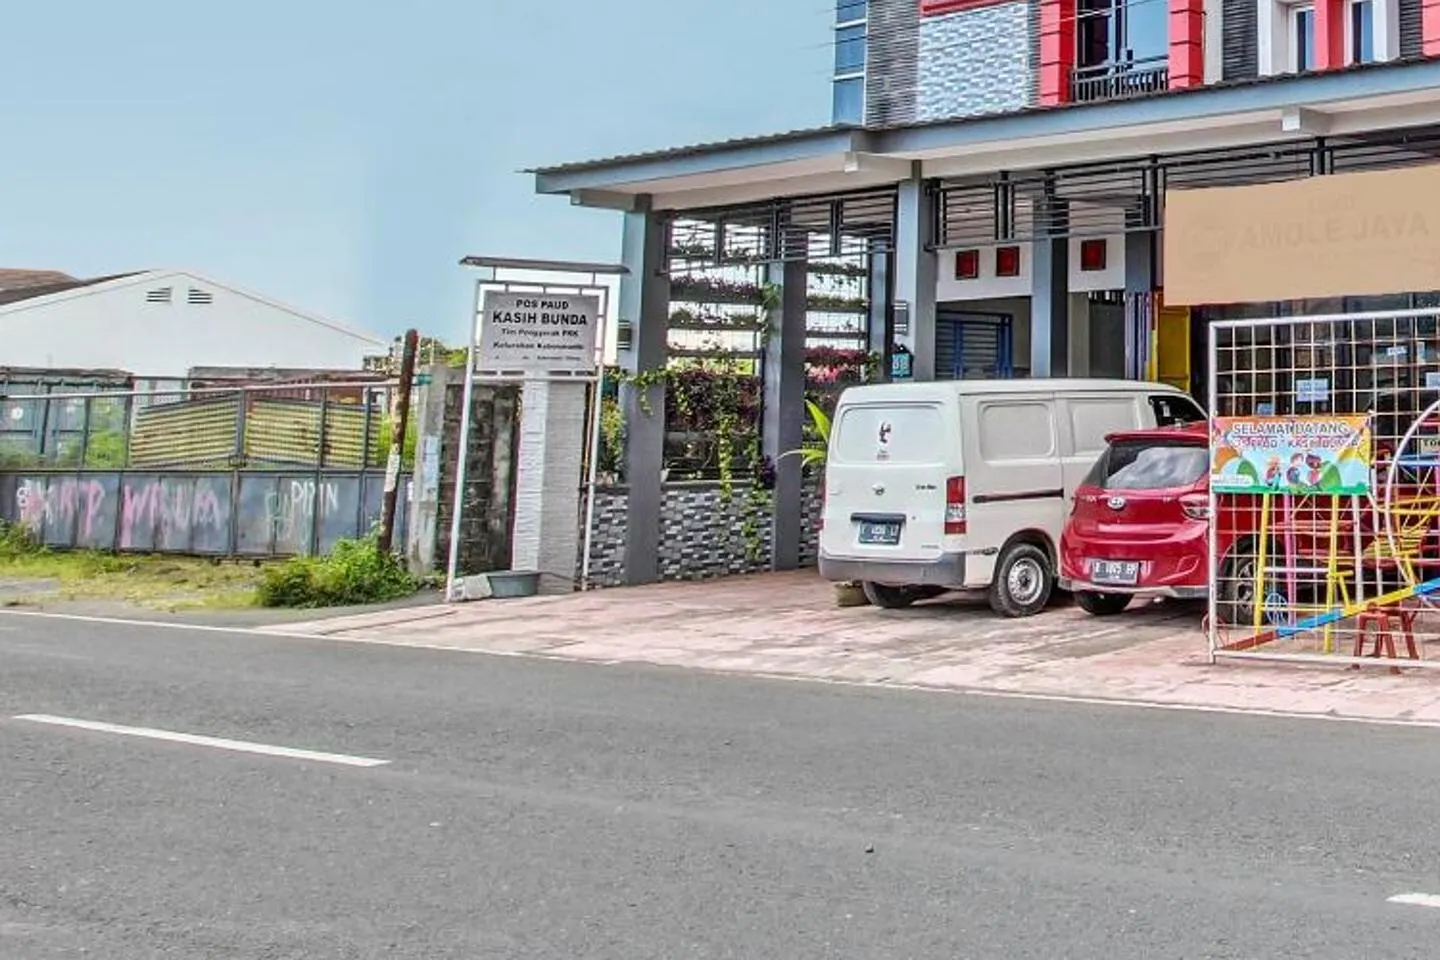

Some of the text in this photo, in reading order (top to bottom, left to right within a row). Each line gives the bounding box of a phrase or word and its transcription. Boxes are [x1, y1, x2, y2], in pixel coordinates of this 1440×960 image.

[1237, 210, 1430, 250] AMOLE JAYA
[516, 299, 569, 309] POS PAUD
[492, 310, 587, 325] KASIH BUNDA
